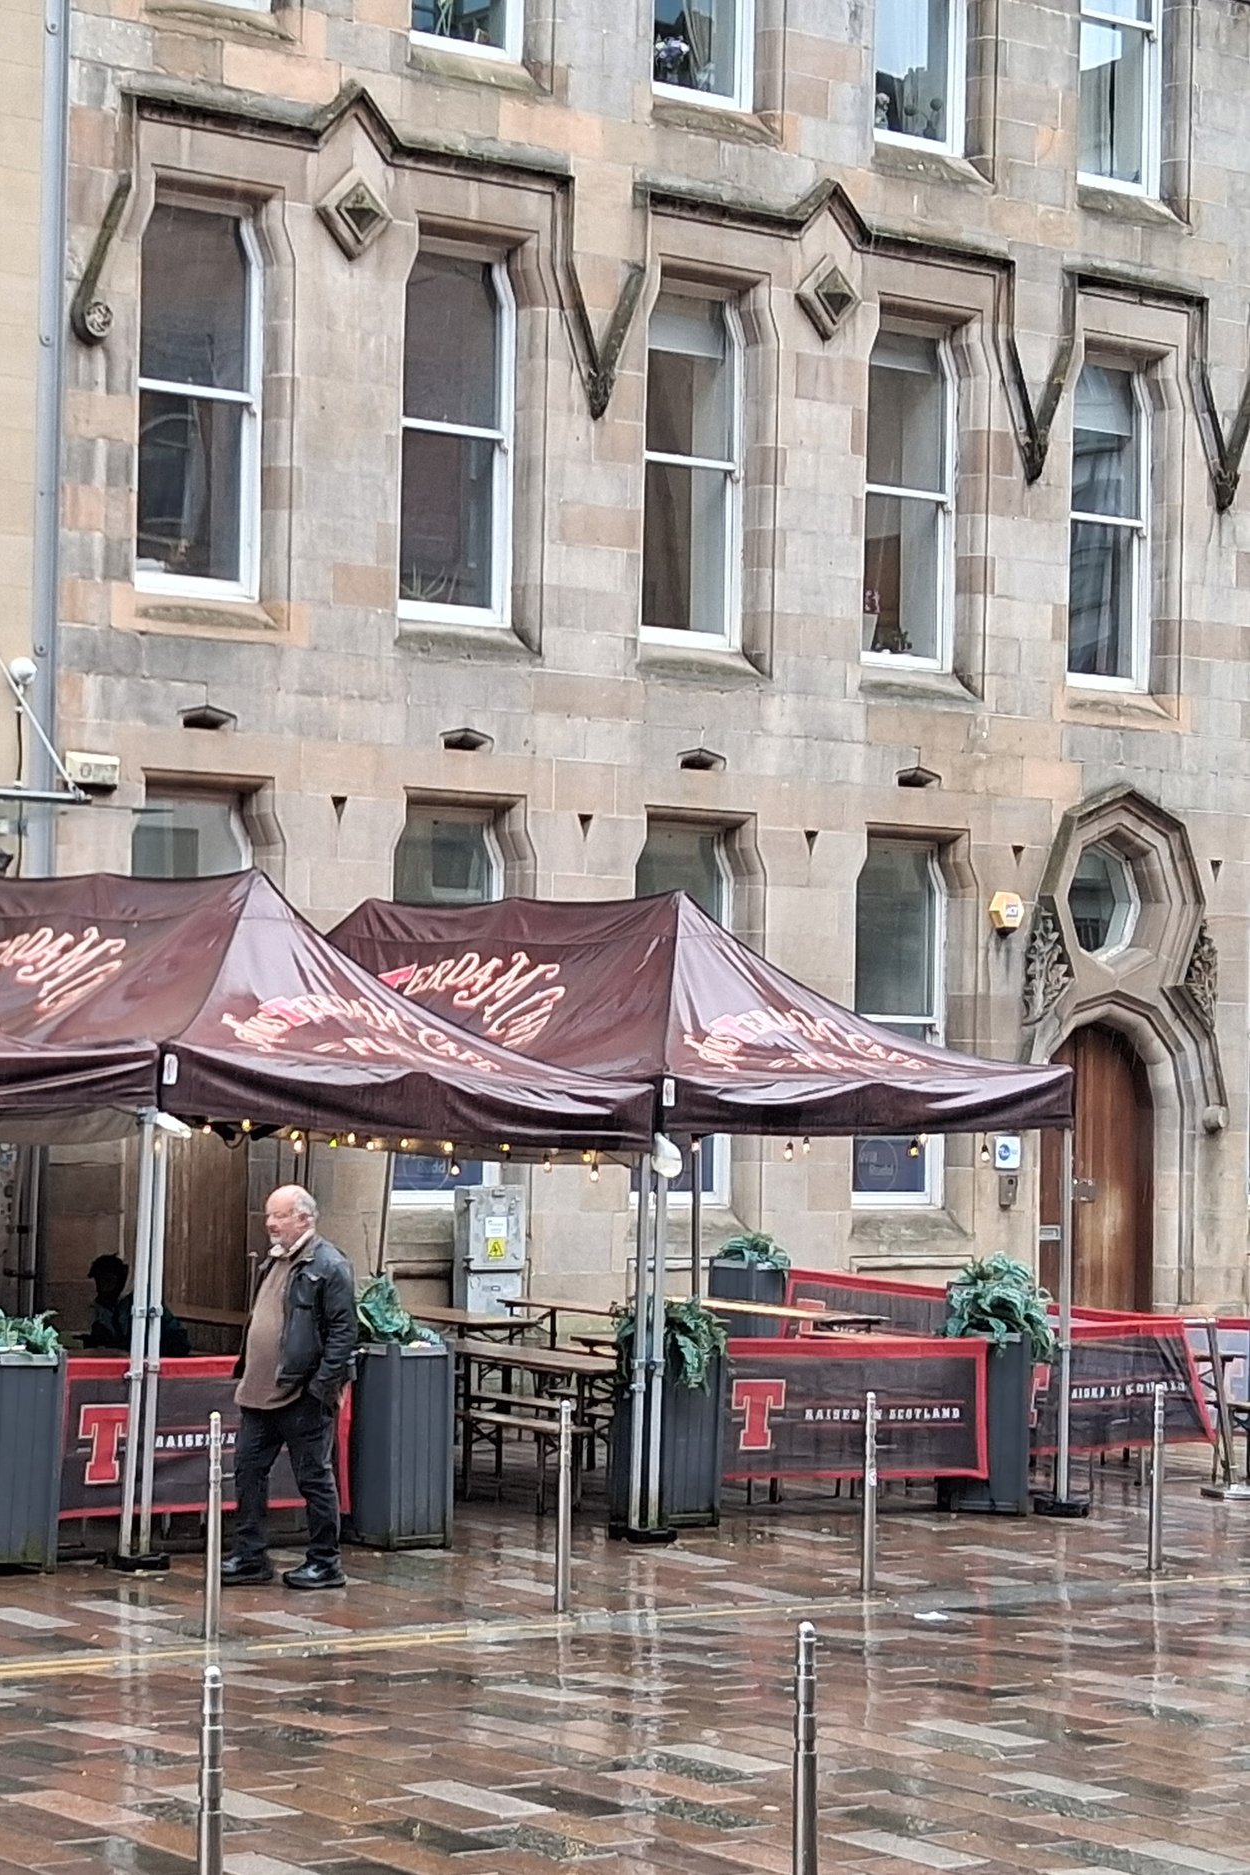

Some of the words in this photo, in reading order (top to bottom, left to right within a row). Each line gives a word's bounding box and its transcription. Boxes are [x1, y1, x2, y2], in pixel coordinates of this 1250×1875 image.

[78, 1403, 130, 1485] T
[732, 1379, 786, 1449] T
[804, 1407, 860, 1421] RAISED
[888, 1406, 961, 1421] SCOTLAND
